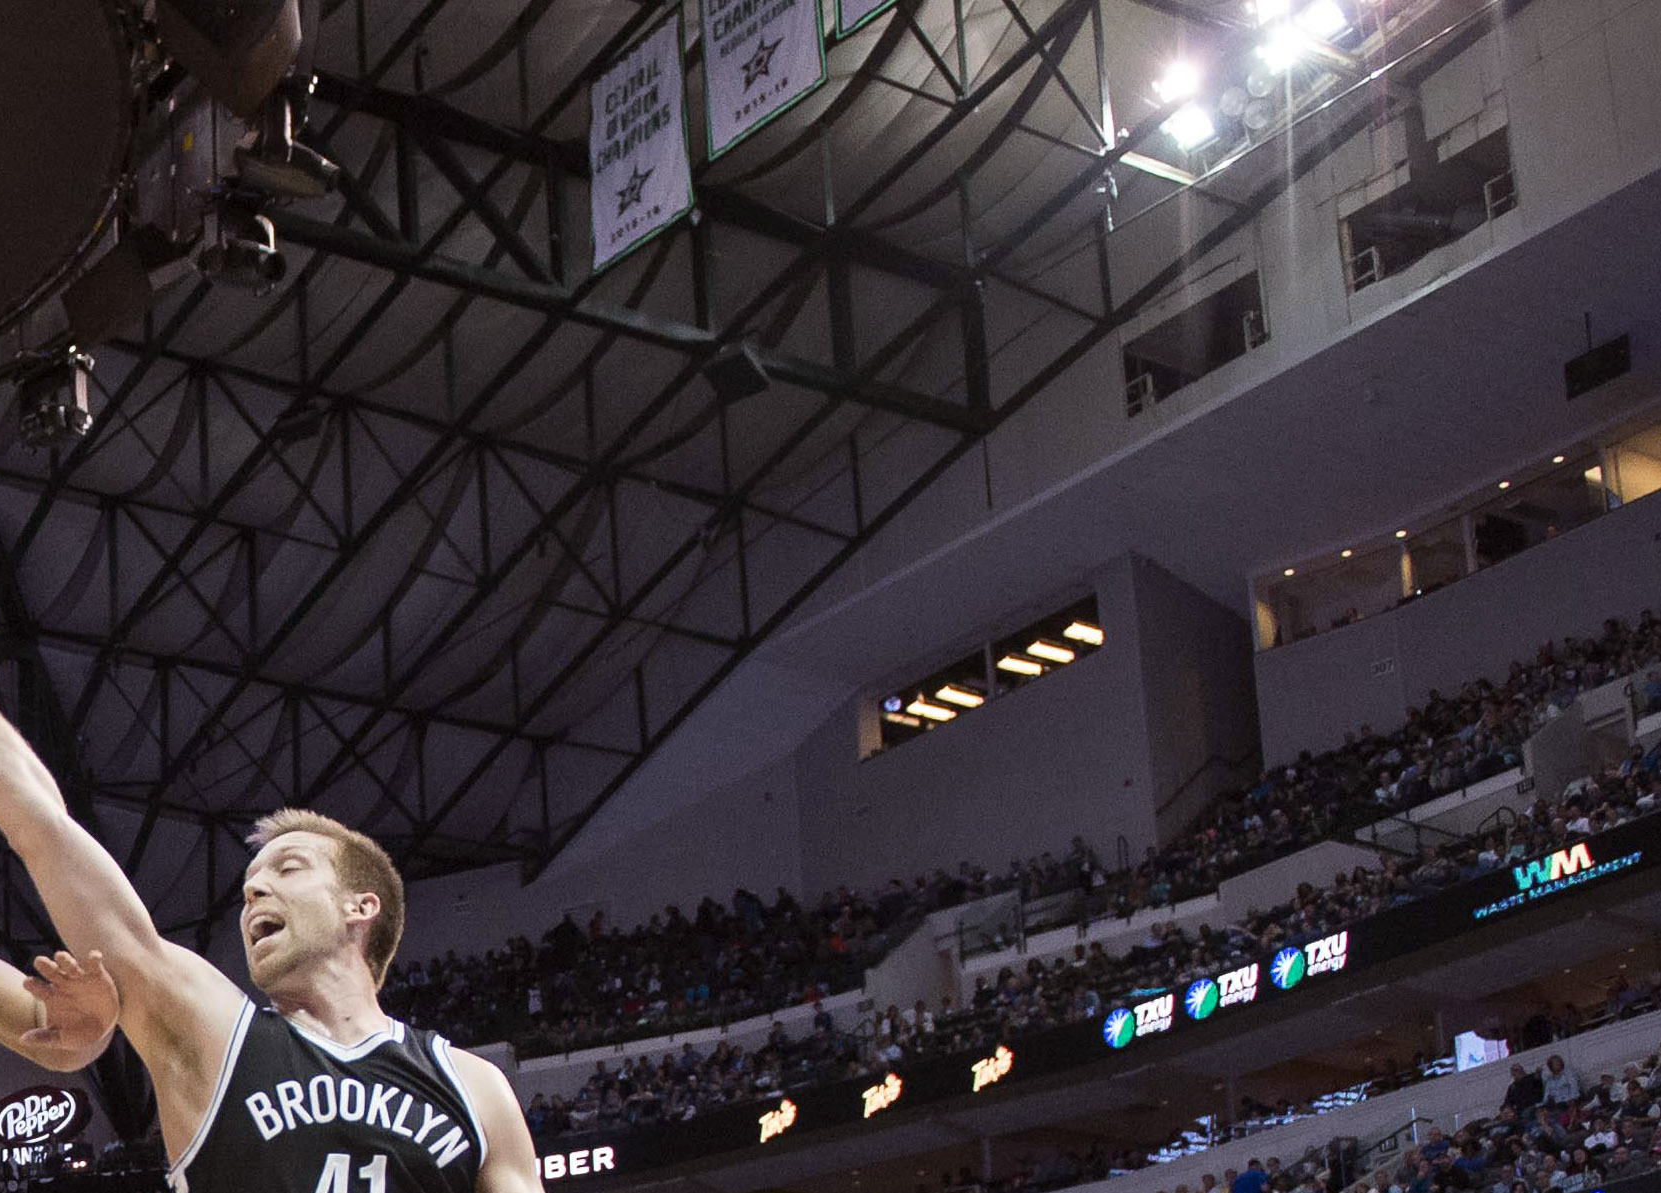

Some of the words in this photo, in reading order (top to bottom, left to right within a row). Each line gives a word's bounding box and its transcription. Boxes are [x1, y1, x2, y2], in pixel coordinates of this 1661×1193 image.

[1514, 843, 1591, 890] WM
[1473, 893, 1525, 919] WASTE
[1529, 851, 1642, 899] MANAGEMENT
[1305, 930, 1348, 963] TXU
[1217, 963, 1259, 996] TXU
[1134, 994, 1174, 1020] TXU
[7, 1100, 70, 1140] Pepper
[24, 1094, 52, 1115] Dr
[245, 1074, 470, 1168] BROOKLYN
[537, 1146, 615, 1181] BER
